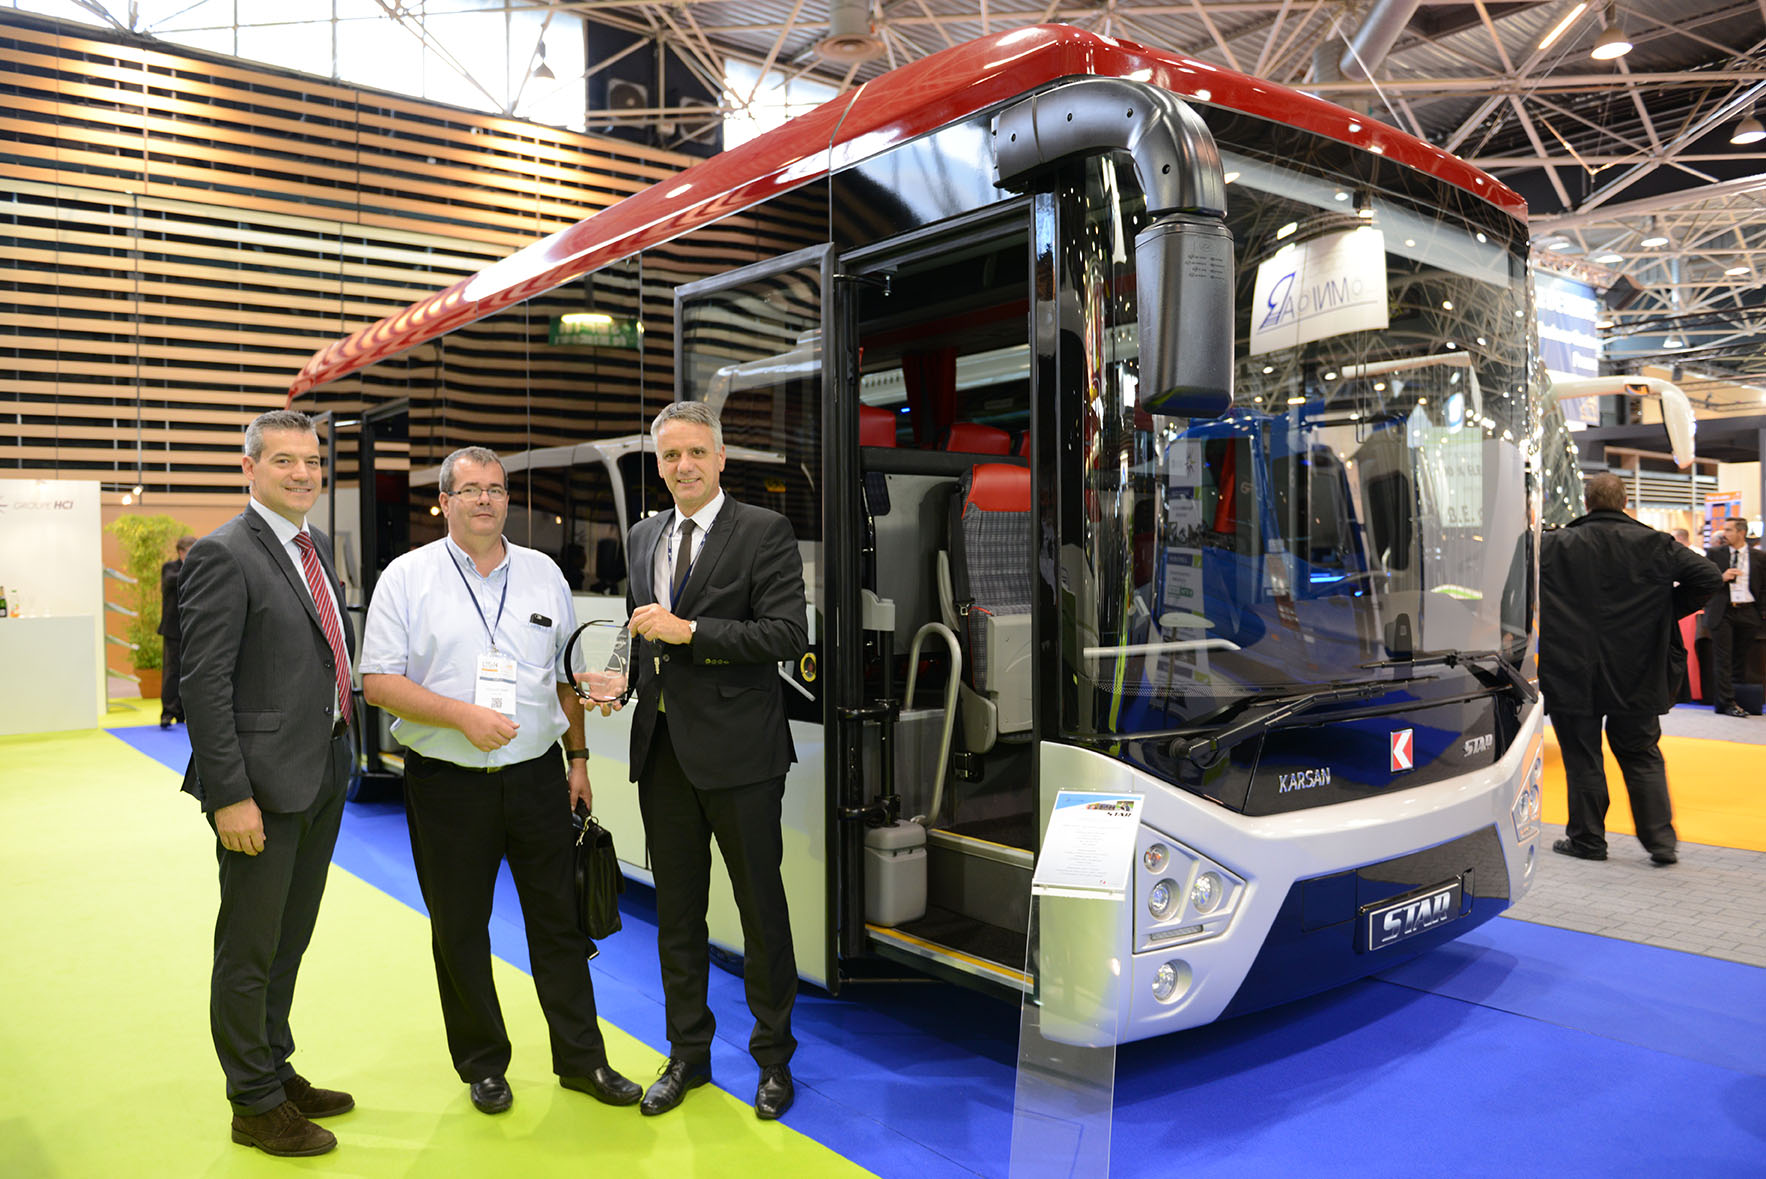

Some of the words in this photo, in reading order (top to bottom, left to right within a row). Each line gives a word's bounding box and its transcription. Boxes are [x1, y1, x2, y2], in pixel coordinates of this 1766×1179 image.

[54, 500, 74, 510] HCI
[1463, 733, 1493, 757] STAR
[1278, 767, 1331, 793] KARSAN
[1382, 891, 1451, 942] STAR
